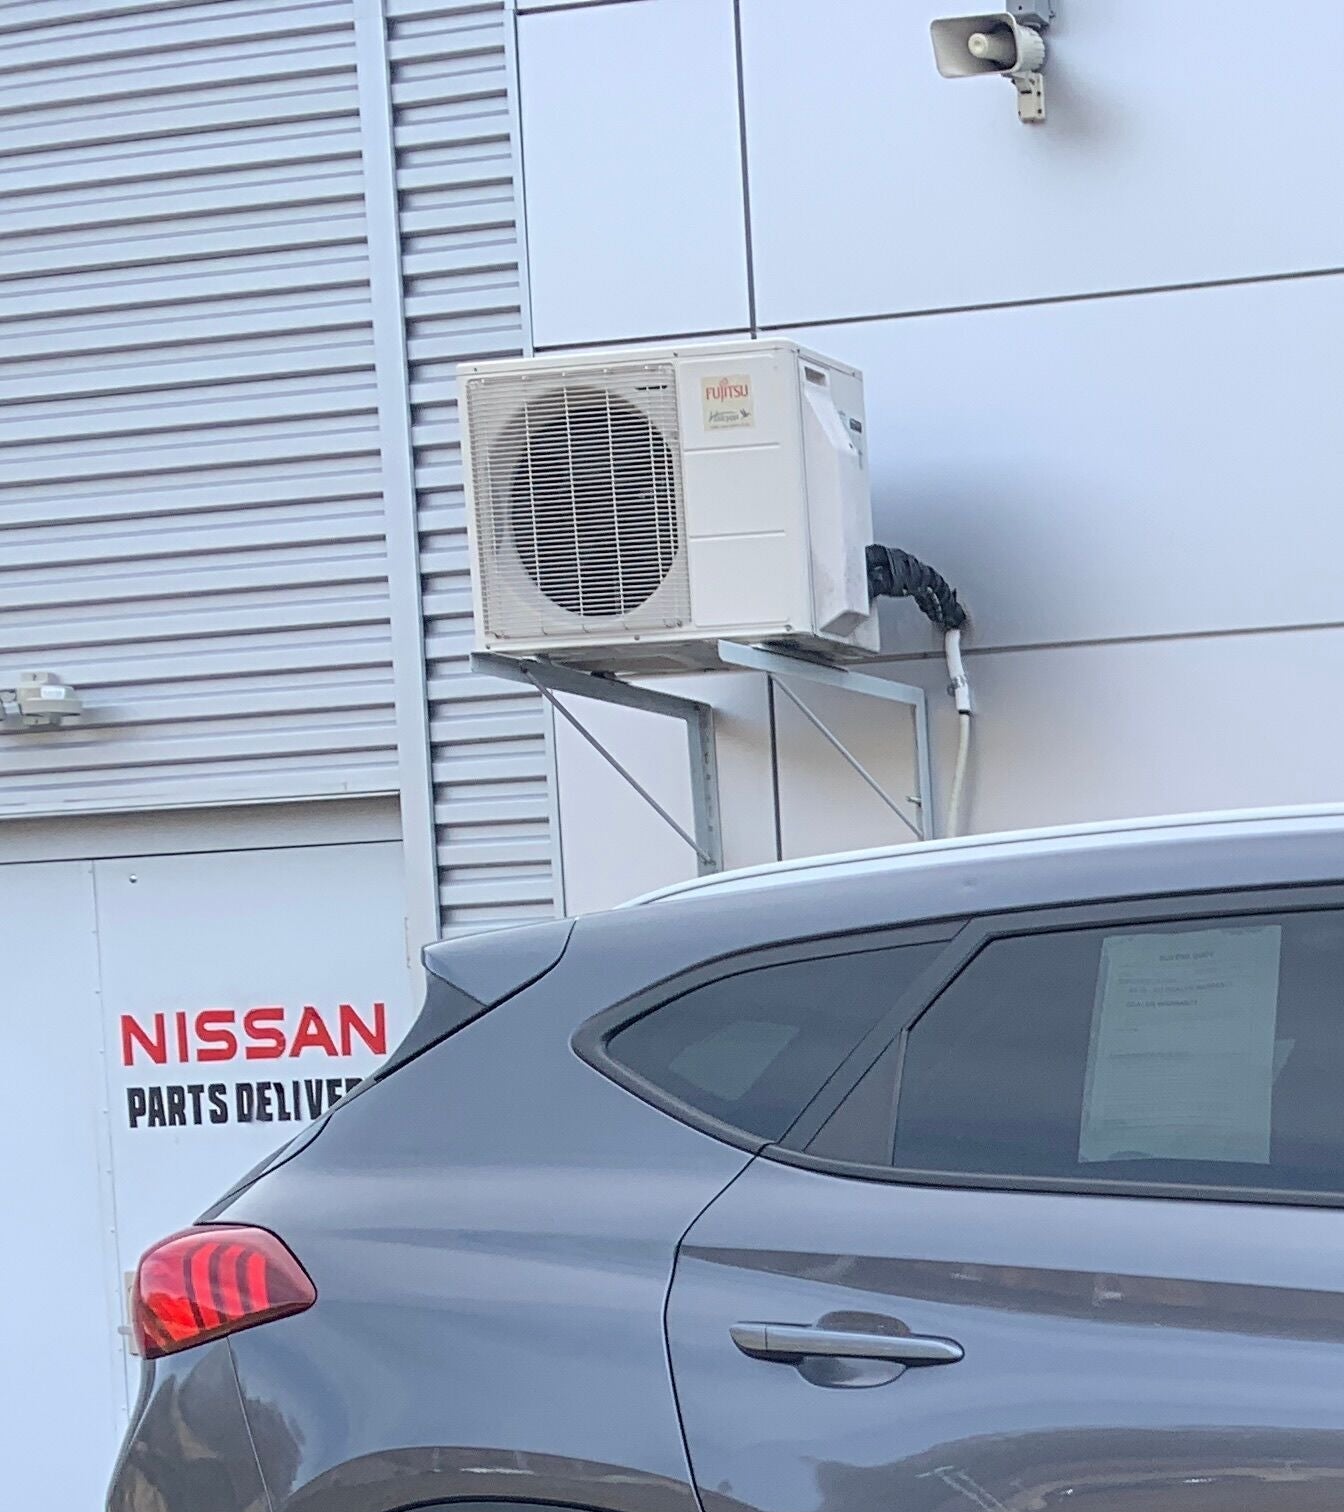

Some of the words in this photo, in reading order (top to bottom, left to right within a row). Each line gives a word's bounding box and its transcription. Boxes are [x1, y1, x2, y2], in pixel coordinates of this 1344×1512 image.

[705, 382, 749, 402] FUJITSU
[121, 1003, 388, 1066] NISSAN
[127, 1082, 229, 1128] PARTS
[235, 1077, 365, 1124] DELIVE
